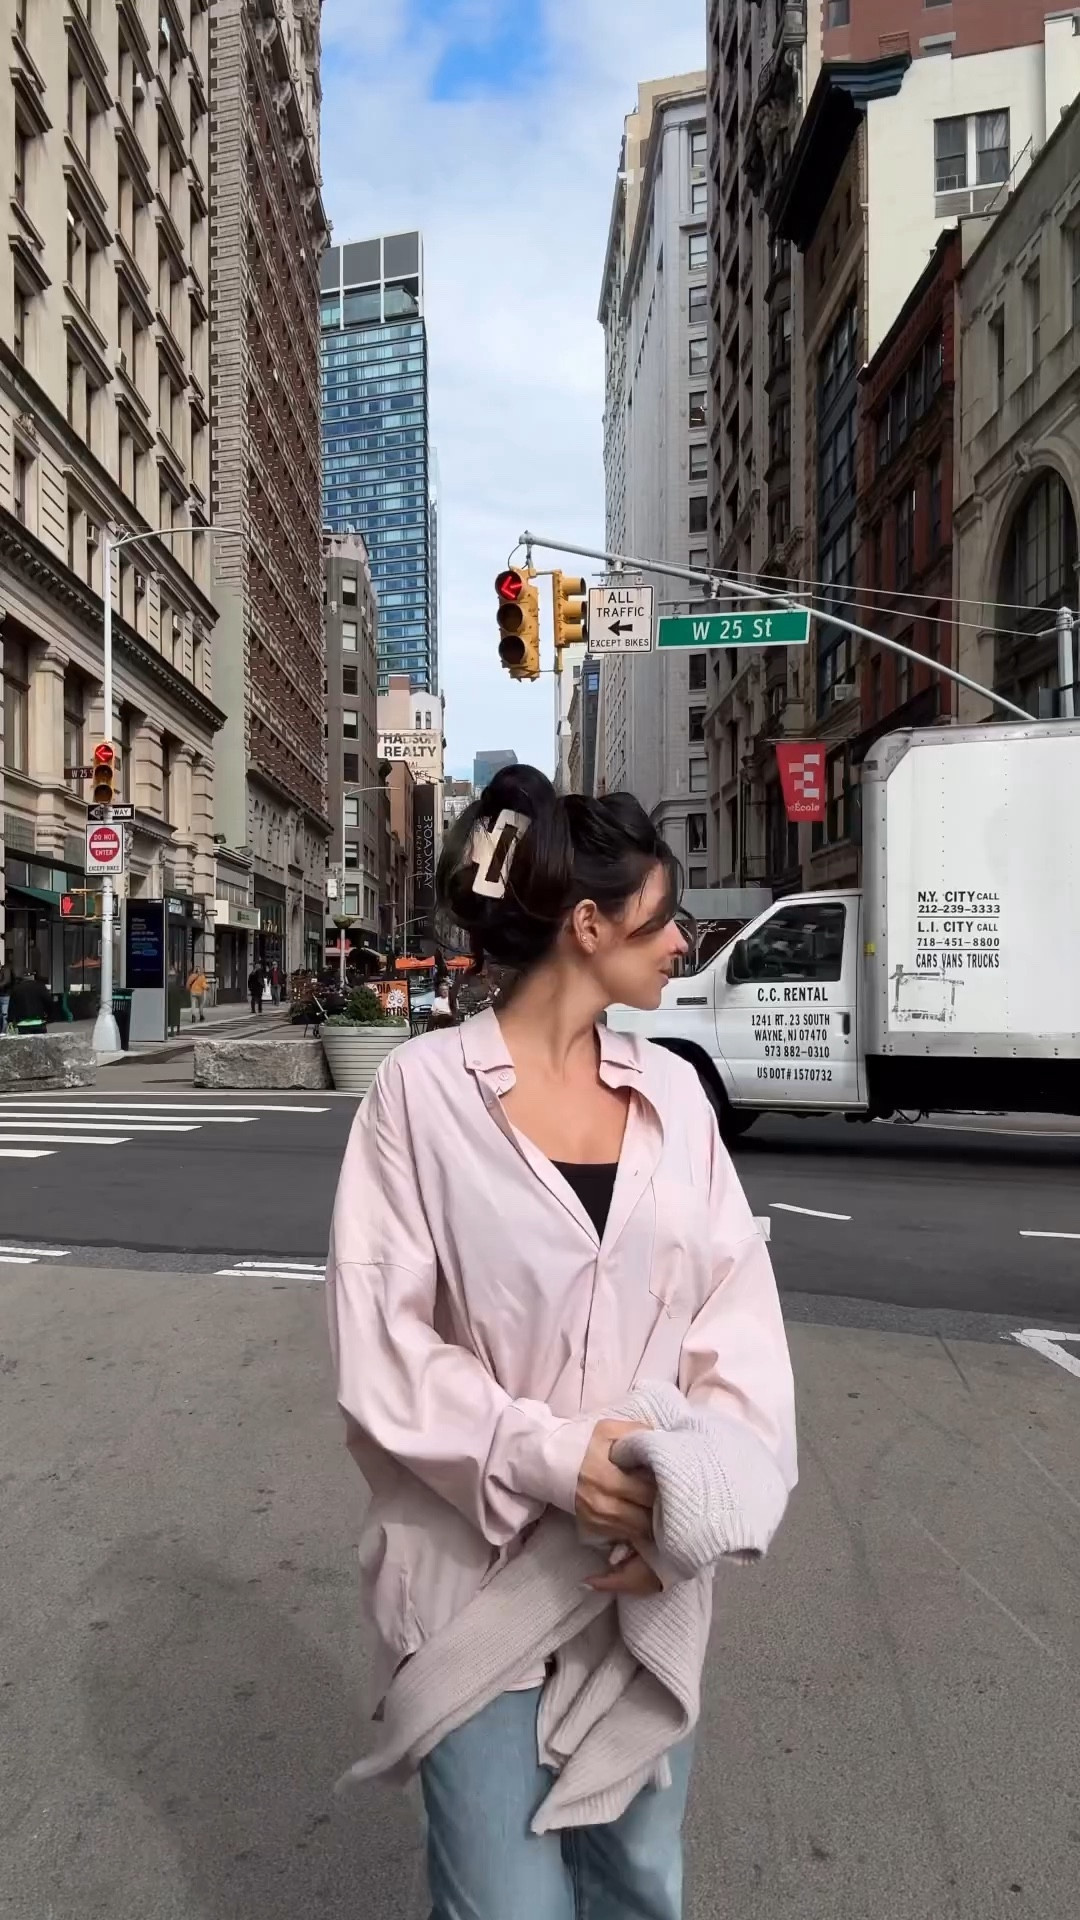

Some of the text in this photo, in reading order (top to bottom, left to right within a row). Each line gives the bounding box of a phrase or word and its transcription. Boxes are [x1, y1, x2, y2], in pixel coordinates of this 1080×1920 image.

[607, 591, 634, 604] ALL
[596, 606, 645, 618] TRAFFIC
[692, 617, 773, 641] W 25 St
[590, 638, 649, 648] EXCEPT BIKES
[384, 746, 437, 757] REALTY
[71, 769, 78, 778] W
[80, 769, 88, 778] 25
[113, 808, 128, 817] WAY
[93, 833, 115, 841] DO NOT
[423, 815, 433, 889] BROADWAY
[917, 891, 1000, 903] N.Y. CITY CALL
[918, 904, 1001, 914] 212-239-3333
[917, 921, 998, 933] L.I. CITY CALL
[916, 937, 1000, 947] 718-451-8800
[915, 953, 1000, 969] CARS VANS TRUCKS
[757, 986, 829, 1002] C.C. RENTAL
[751, 1013, 830, 1026] 1241 RT. 23 SOUTH
[754, 1029, 828, 1044] WAYNE, NJ 07470
[764, 1045, 830, 1058] 973 882-0310
[794, 1068, 832, 1081] 1570732
